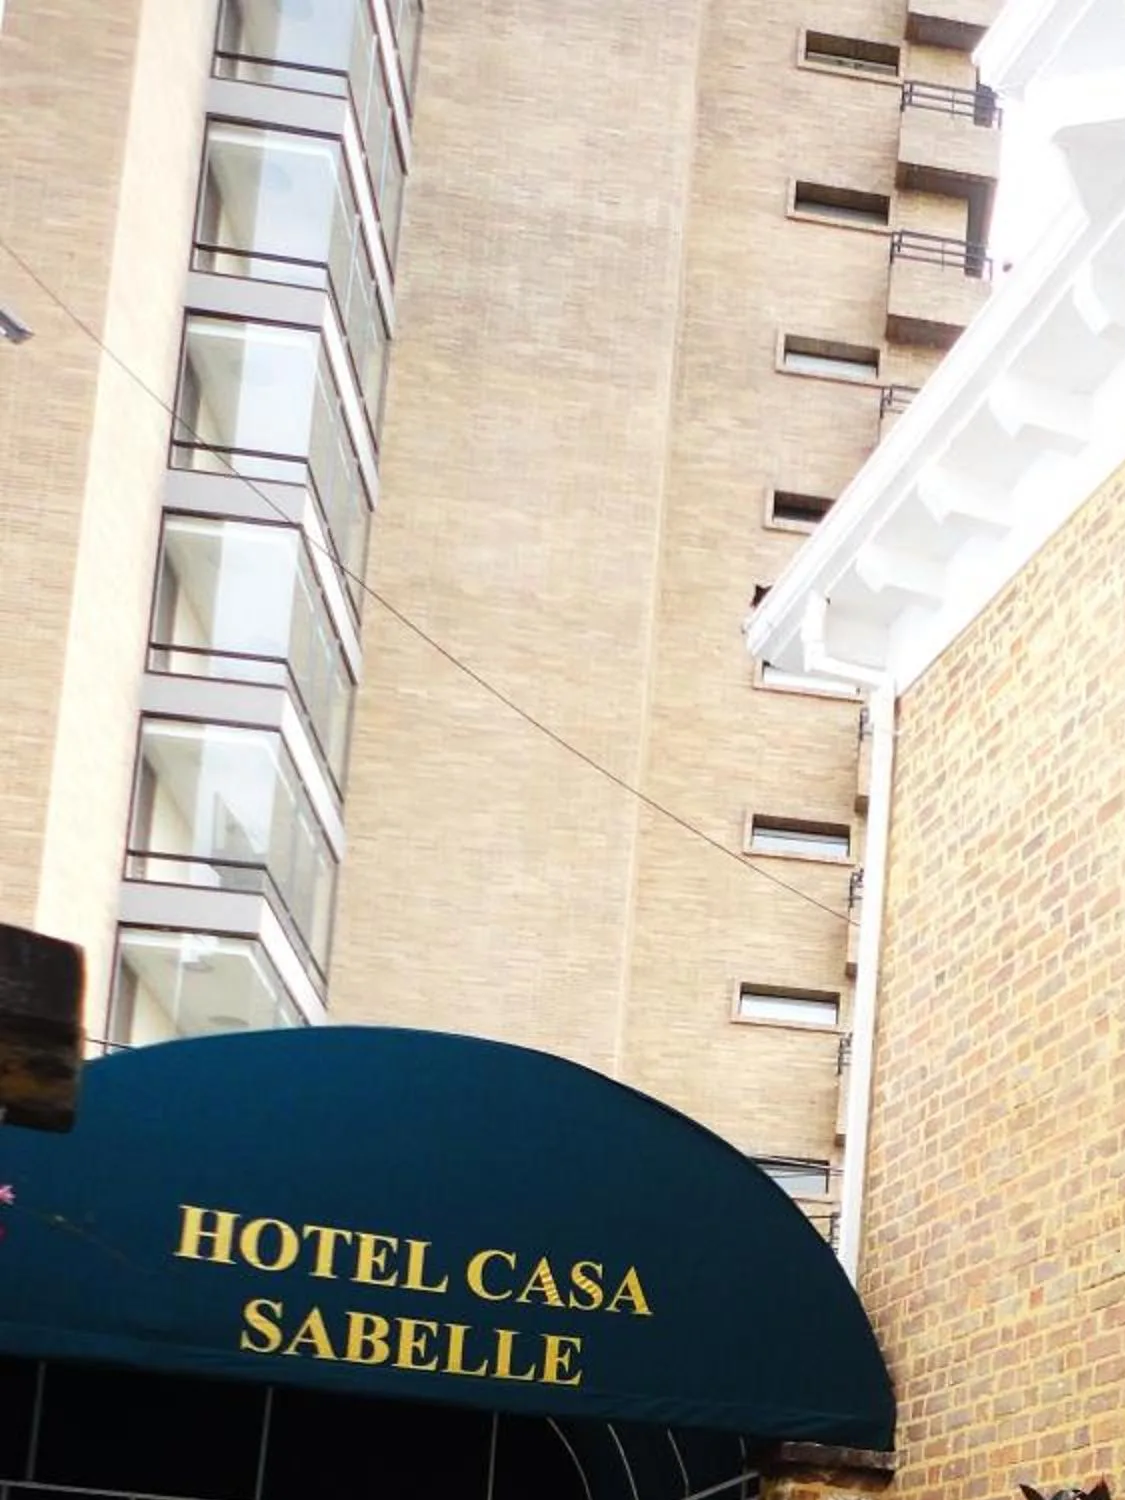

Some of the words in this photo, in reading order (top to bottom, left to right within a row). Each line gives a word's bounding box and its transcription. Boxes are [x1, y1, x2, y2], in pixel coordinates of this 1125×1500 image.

[174, 1204, 449, 1293] HOTEL
[466, 1249, 653, 1316] CASA
[240, 1298, 583, 1386] SABELLE
